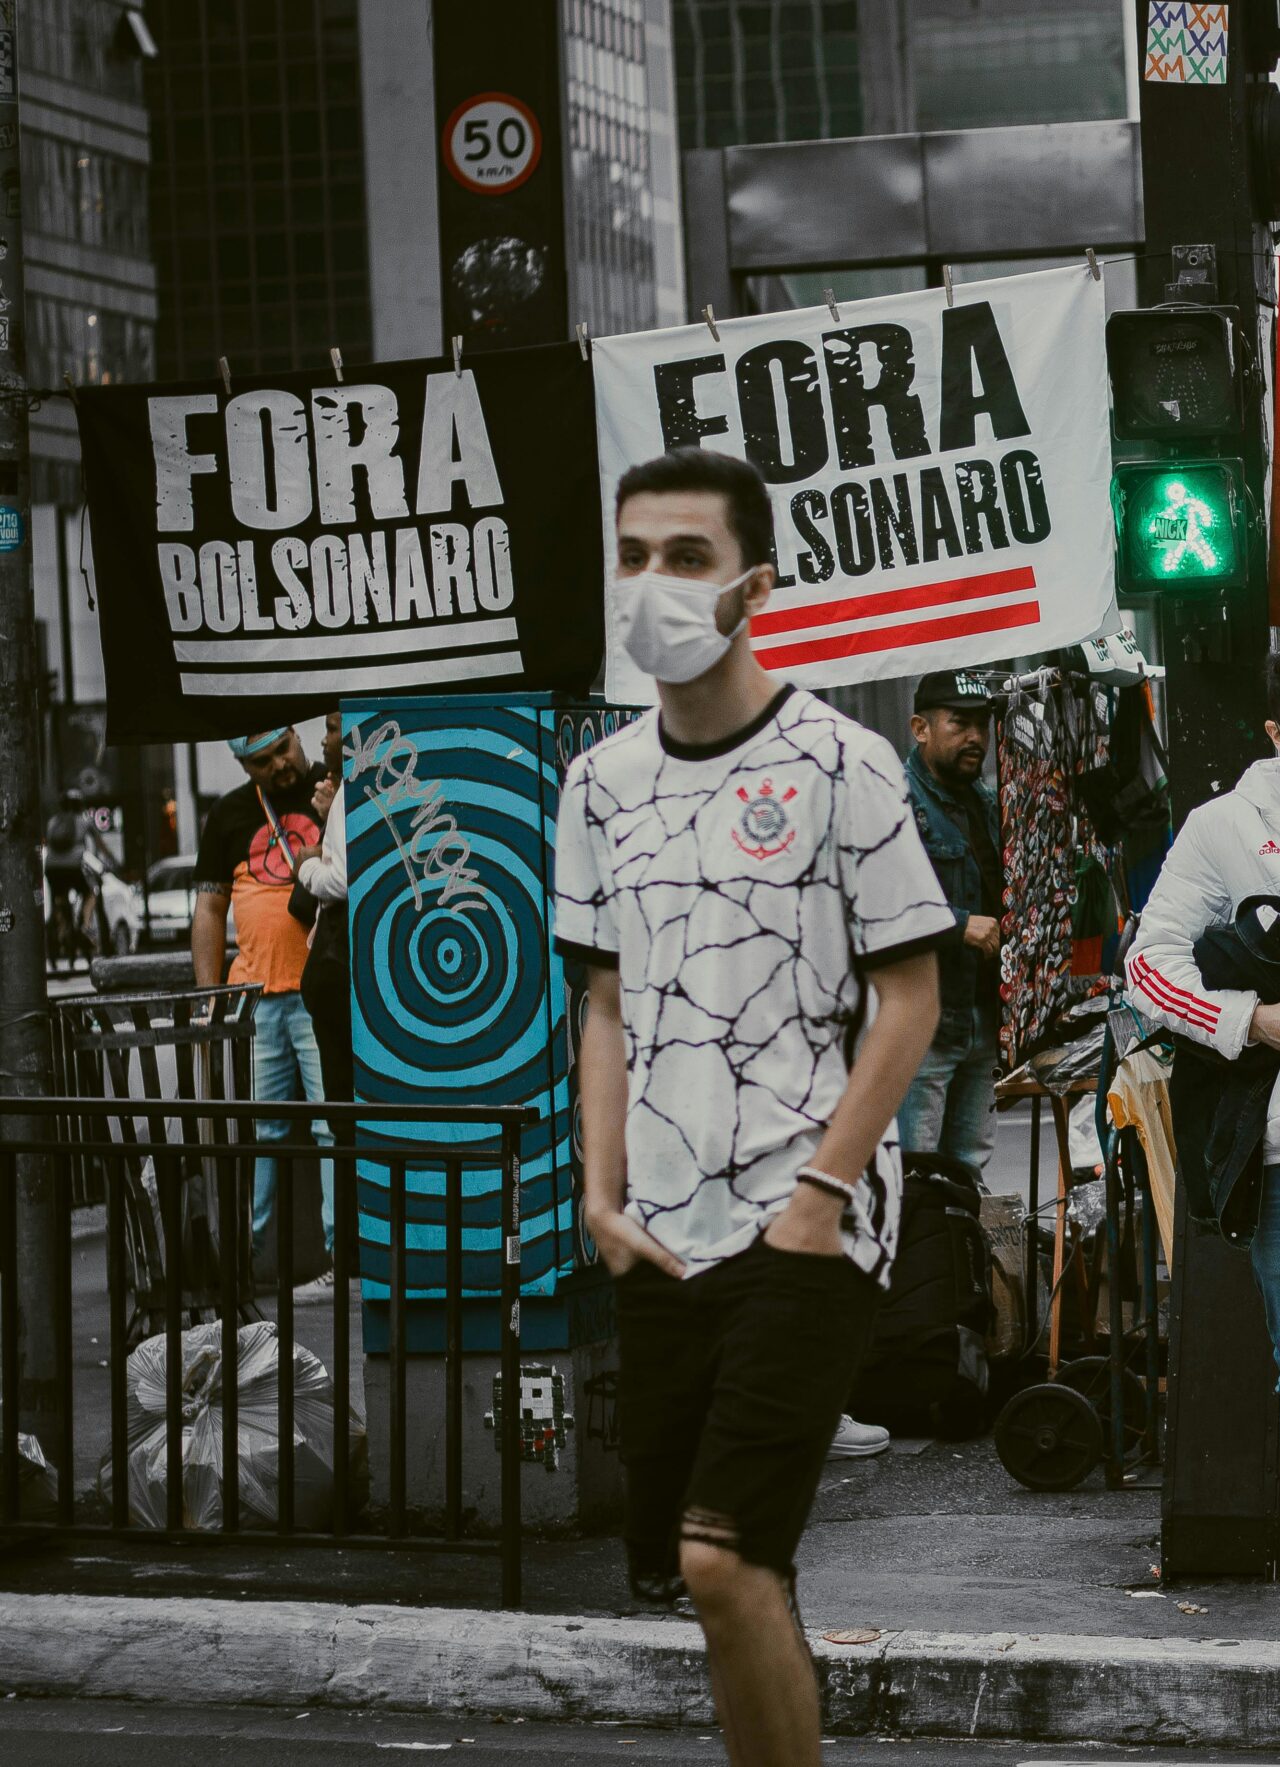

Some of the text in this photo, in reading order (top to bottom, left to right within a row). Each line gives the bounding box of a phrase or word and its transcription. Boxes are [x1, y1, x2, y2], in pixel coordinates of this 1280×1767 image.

[463, 117, 527, 162] 50
[476, 164, 515, 179] km/h
[654, 301, 1032, 484] FORA
[148, 370, 504, 532] FORA
[1155, 518, 1187, 540] NICK
[157, 517, 514, 633] BOLSONARO
